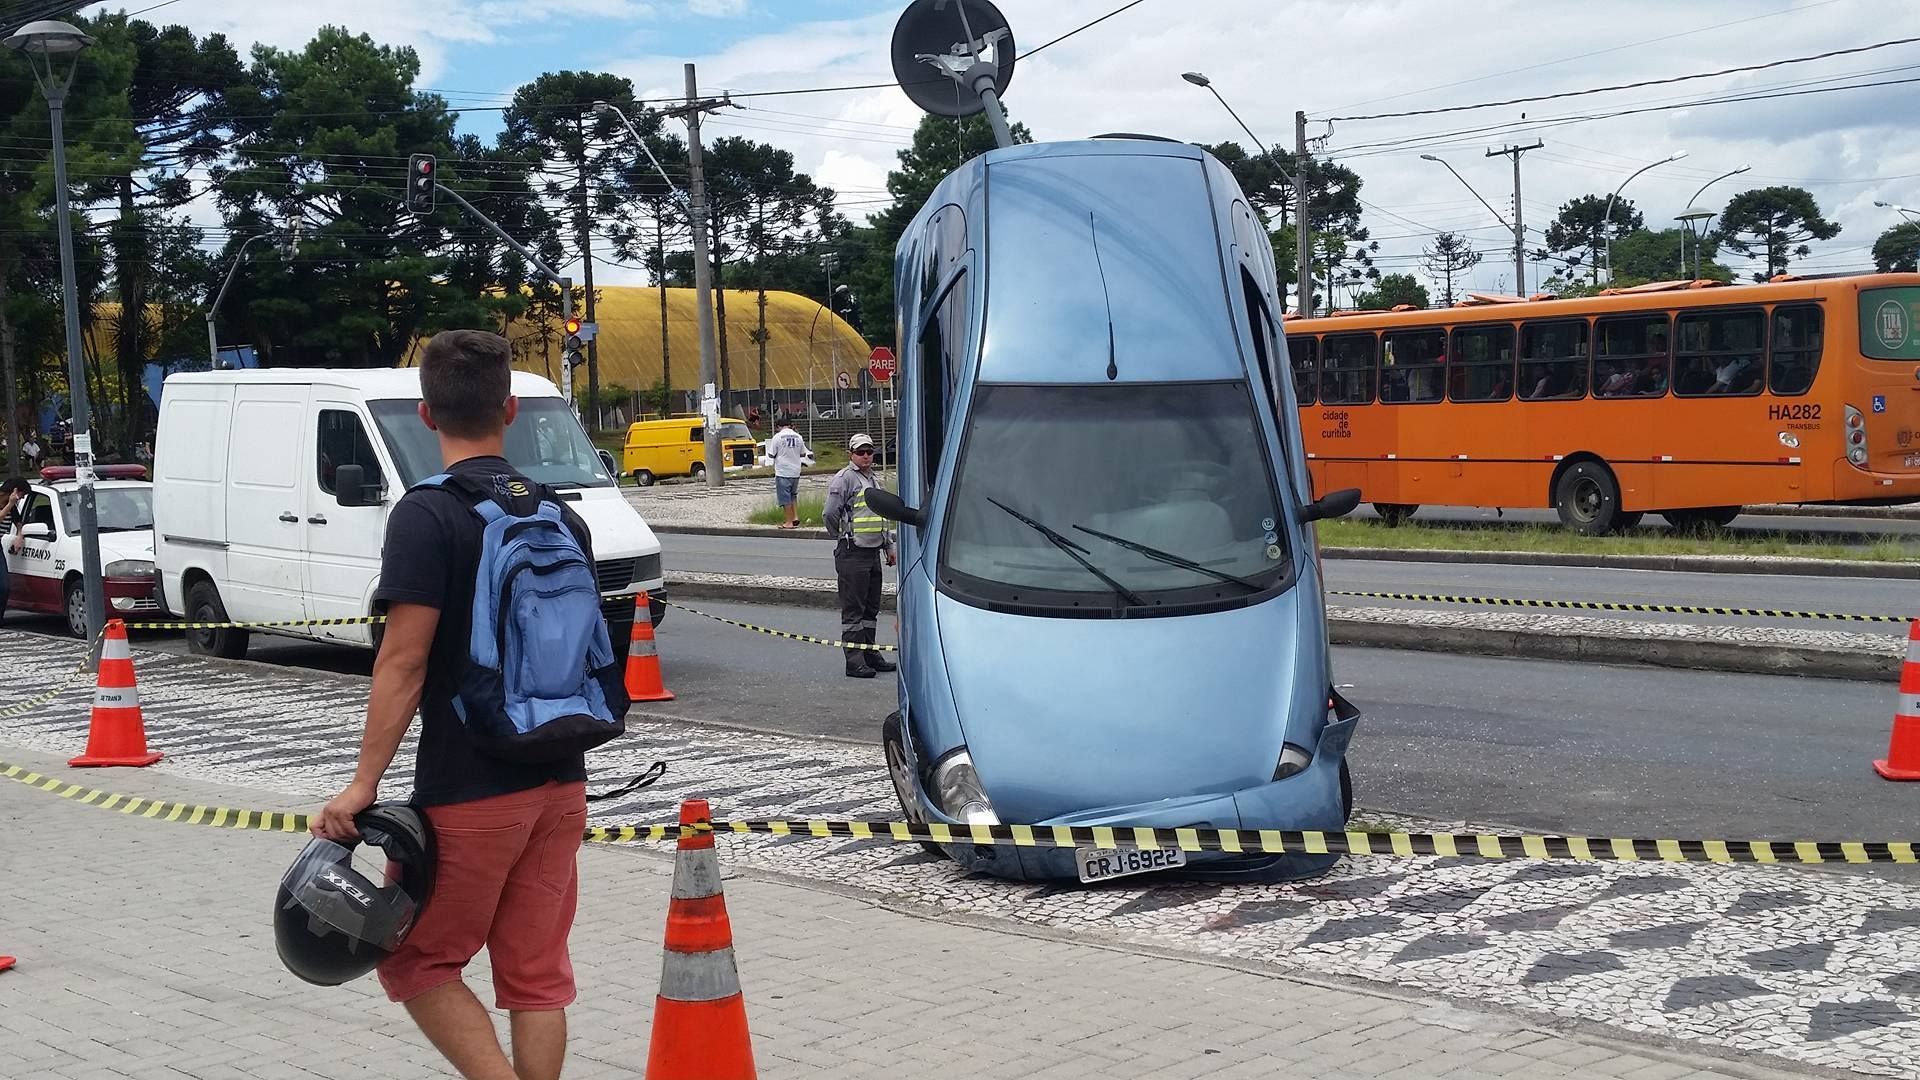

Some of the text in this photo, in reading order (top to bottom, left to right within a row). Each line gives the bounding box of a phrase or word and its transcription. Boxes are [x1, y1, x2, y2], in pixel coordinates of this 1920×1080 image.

[870, 359, 895, 370] PARE
[1322, 410, 1348, 420] cidade
[1769, 404, 1821, 420] HA282
[1338, 420, 1348, 429] de
[1321, 428, 1351, 438] curitiba
[786, 437, 796, 447] 71
